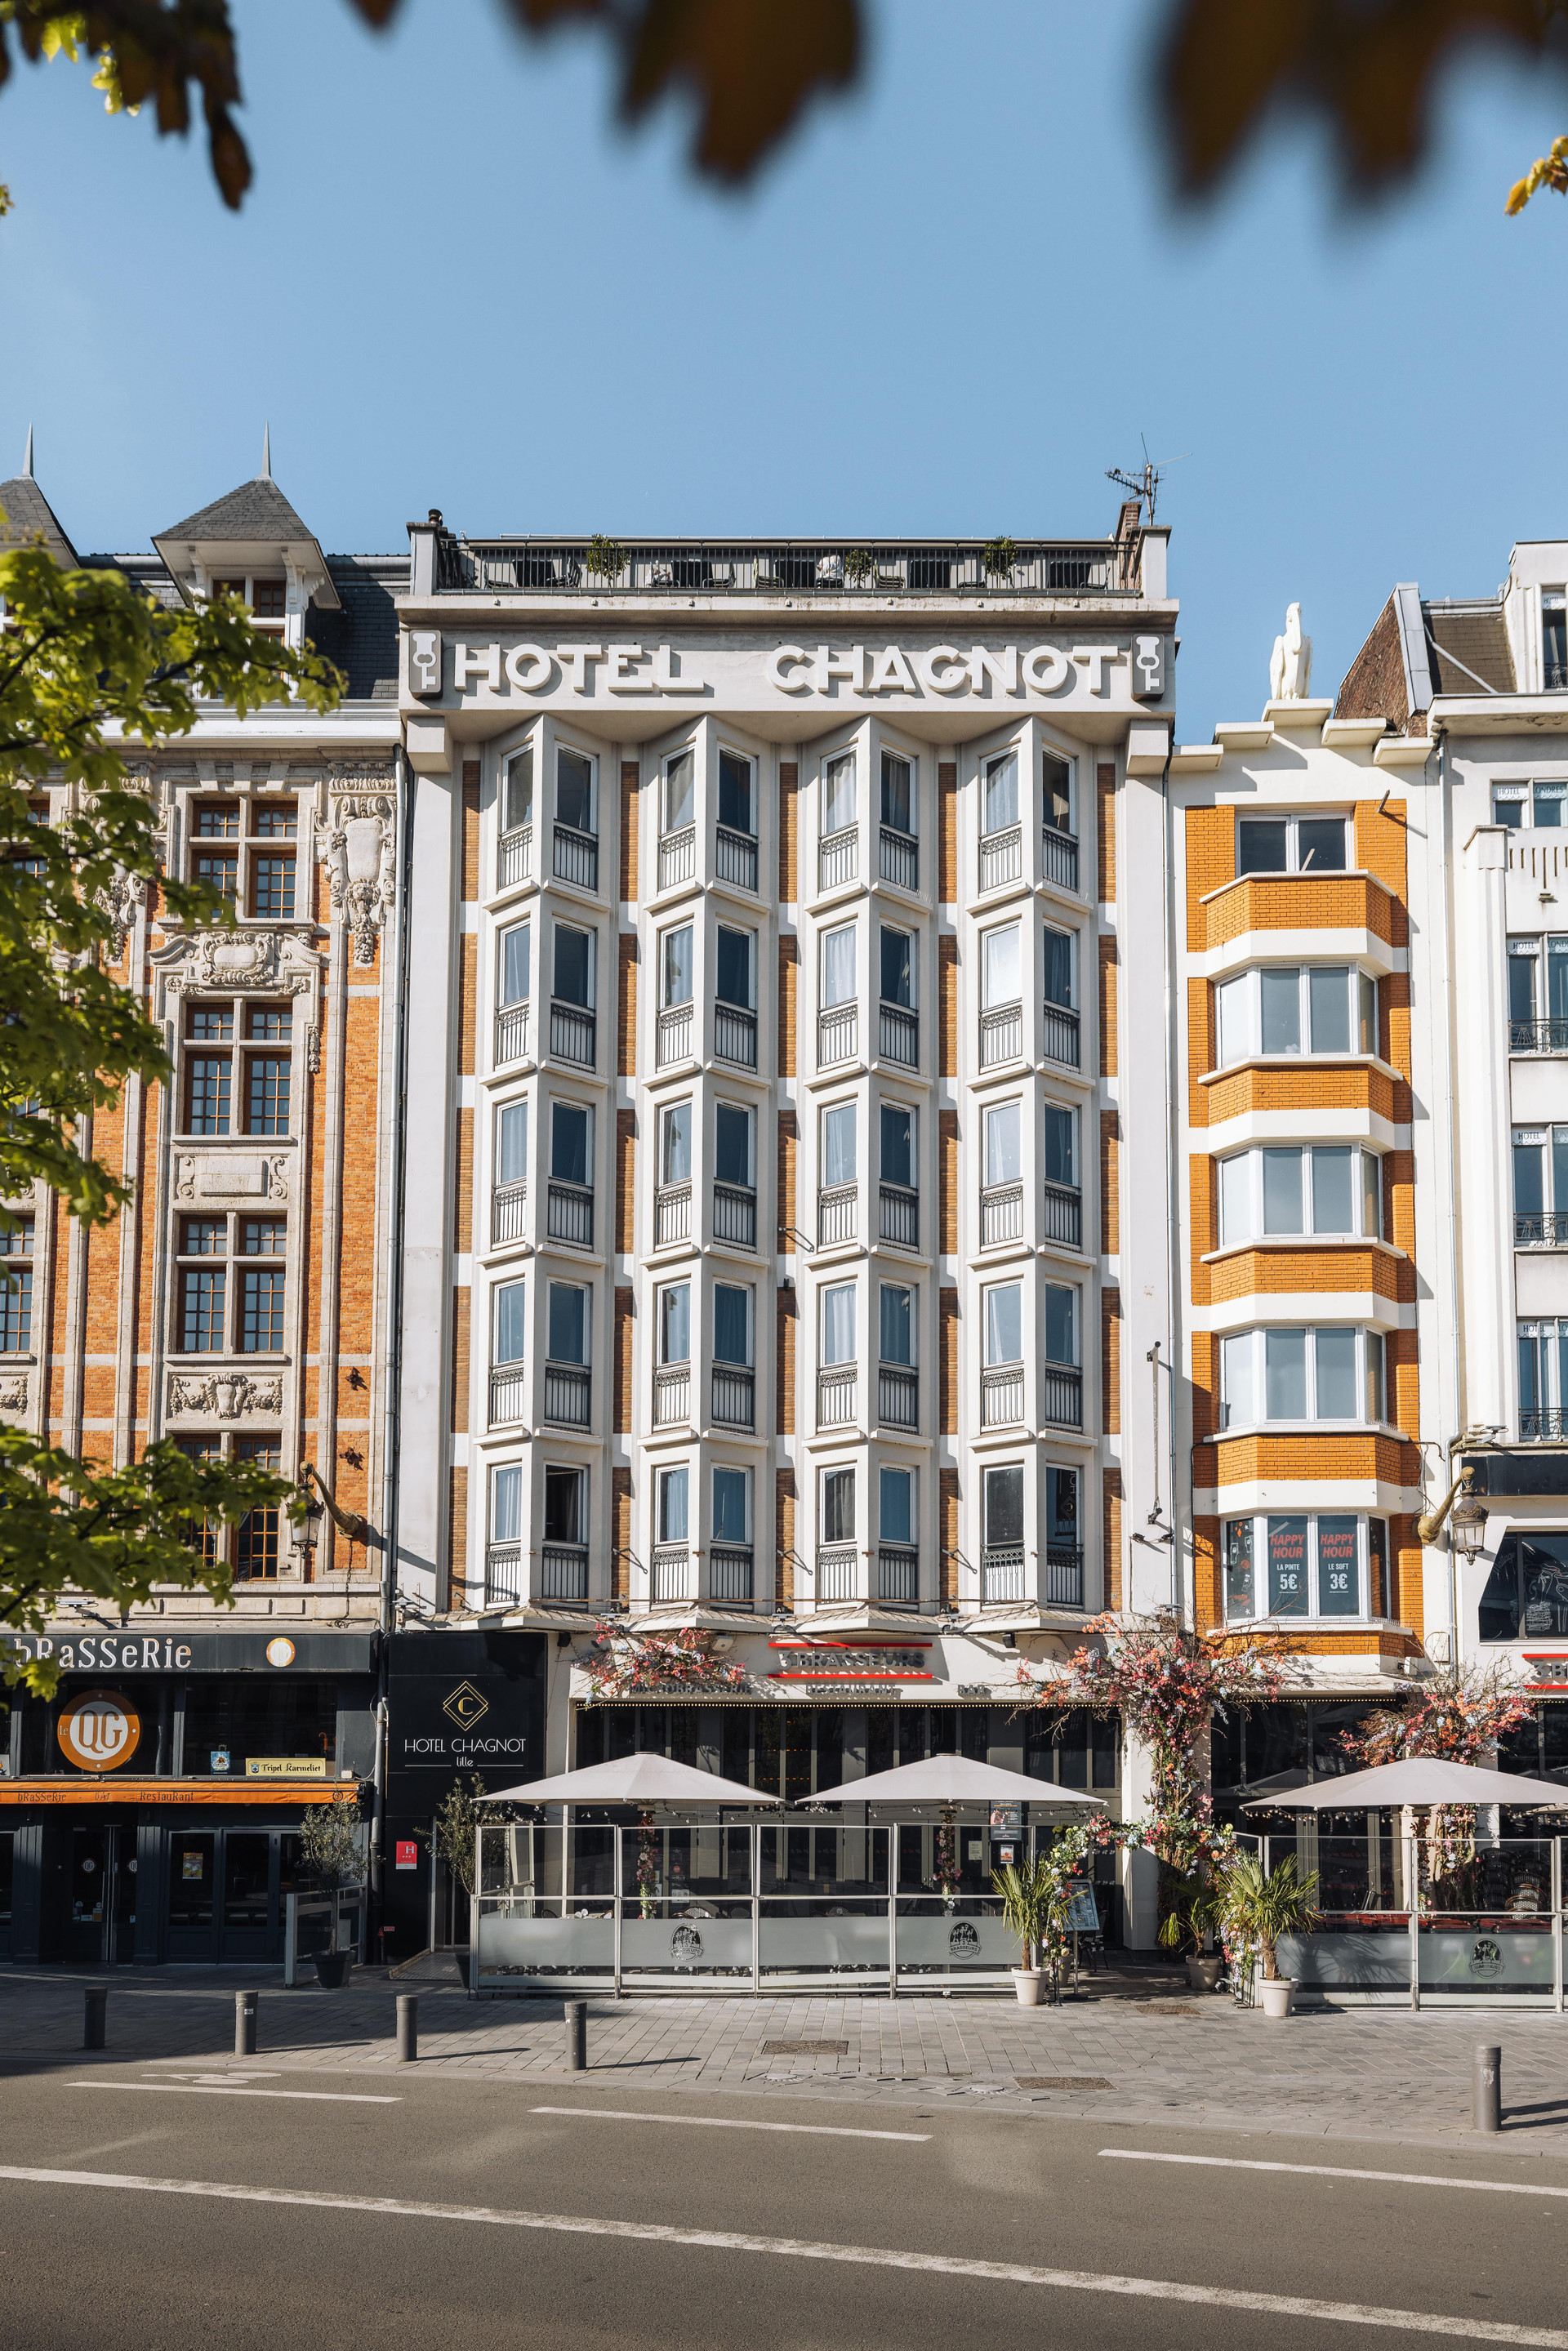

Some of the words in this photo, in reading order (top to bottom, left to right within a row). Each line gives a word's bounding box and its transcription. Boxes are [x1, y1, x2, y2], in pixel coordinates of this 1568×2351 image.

[454, 643, 704, 692] HOTEL
[766, 644, 1119, 693] CHAGNOT
[1535, 786, 1564, 794] ONDRES
[1270, 1534, 1305, 1546] HAPPY
[1320, 1534, 1356, 1546] HAPPY
[1272, 1547, 1304, 1559] HOUR
[1322, 1546, 1354, 1558] HOUR
[1280, 1573, 1298, 1590] 5€
[1330, 1573, 1348, 1590] 3€
[777, 1650, 792, 1671] 3
[796, 1652, 925, 1669] BRASSEURS
[1530, 1661, 1547, 1681] 3
[1552, 1663, 1568, 1679] B
[805, 1683, 896, 1695] RESTAURANT
[957, 1684, 987, 1695] BAR
[78, 1710, 122, 1753] QG
[404, 1739, 447, 1752] HOTEL
[451, 1739, 526, 1752] CHAGNOT
[456, 1757, 474, 1766] lille
[405, 1846, 415, 1855] H
